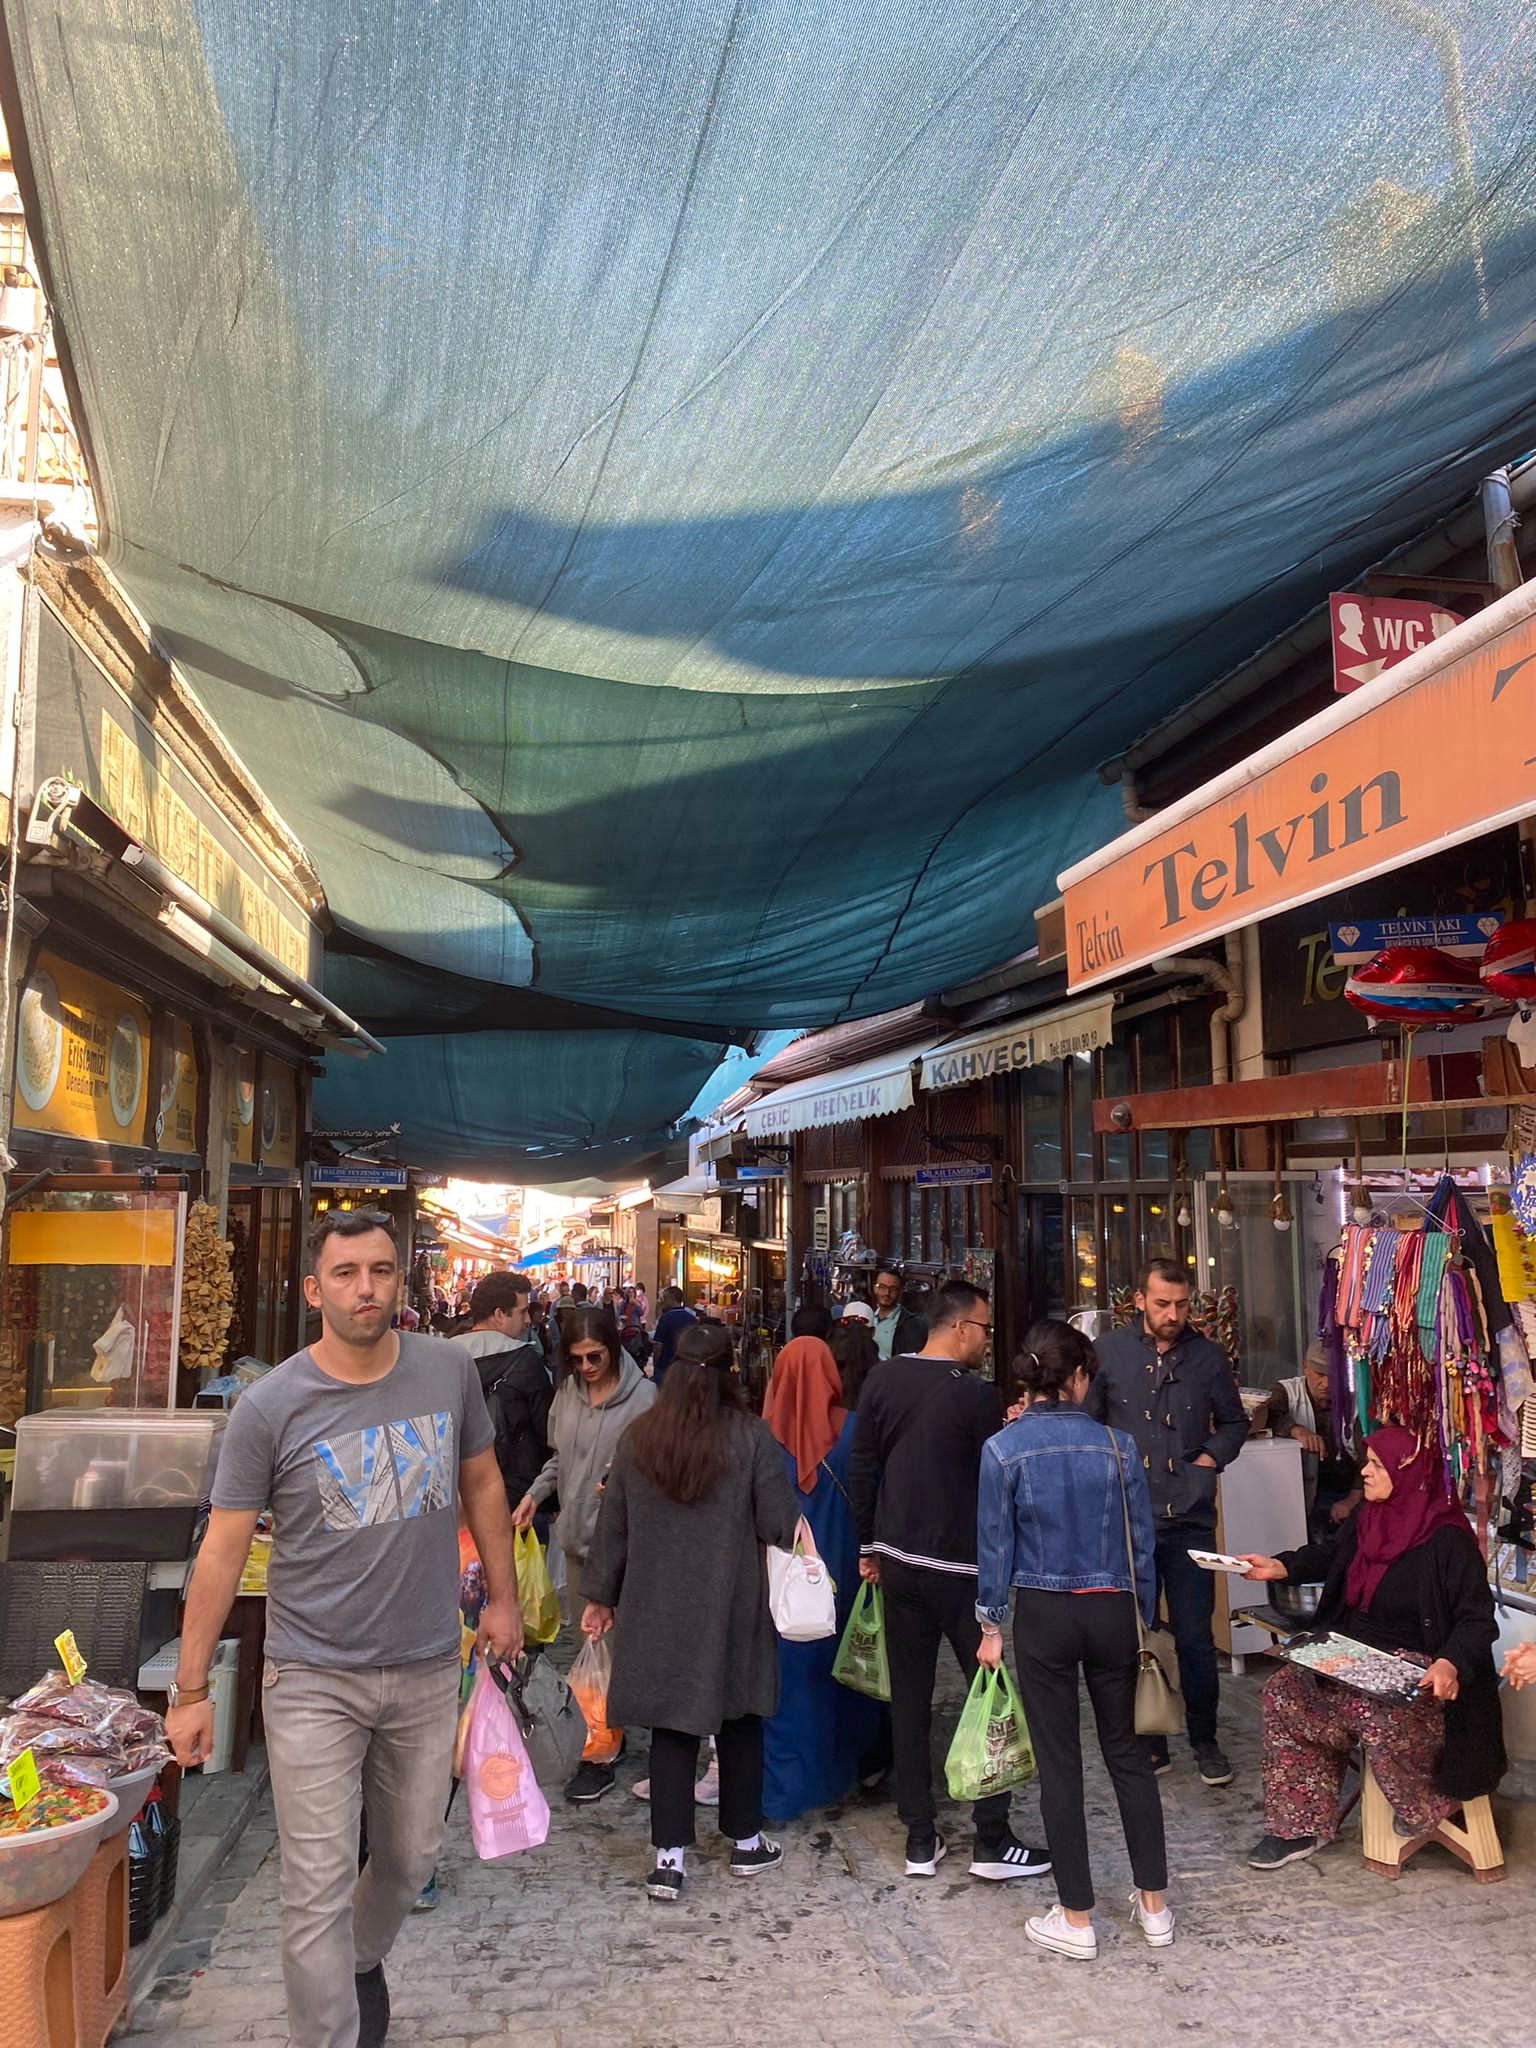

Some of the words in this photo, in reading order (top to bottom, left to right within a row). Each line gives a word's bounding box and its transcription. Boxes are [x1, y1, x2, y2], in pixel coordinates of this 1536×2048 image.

[1373, 616, 1425, 653] WC
[1143, 769, 1409, 930] Telvin
[1076, 909, 1125, 973] Telvin
[932, 1032, 1035, 1085] KAHVECİ
[813, 1085, 881, 1119] HEDİYELİK
